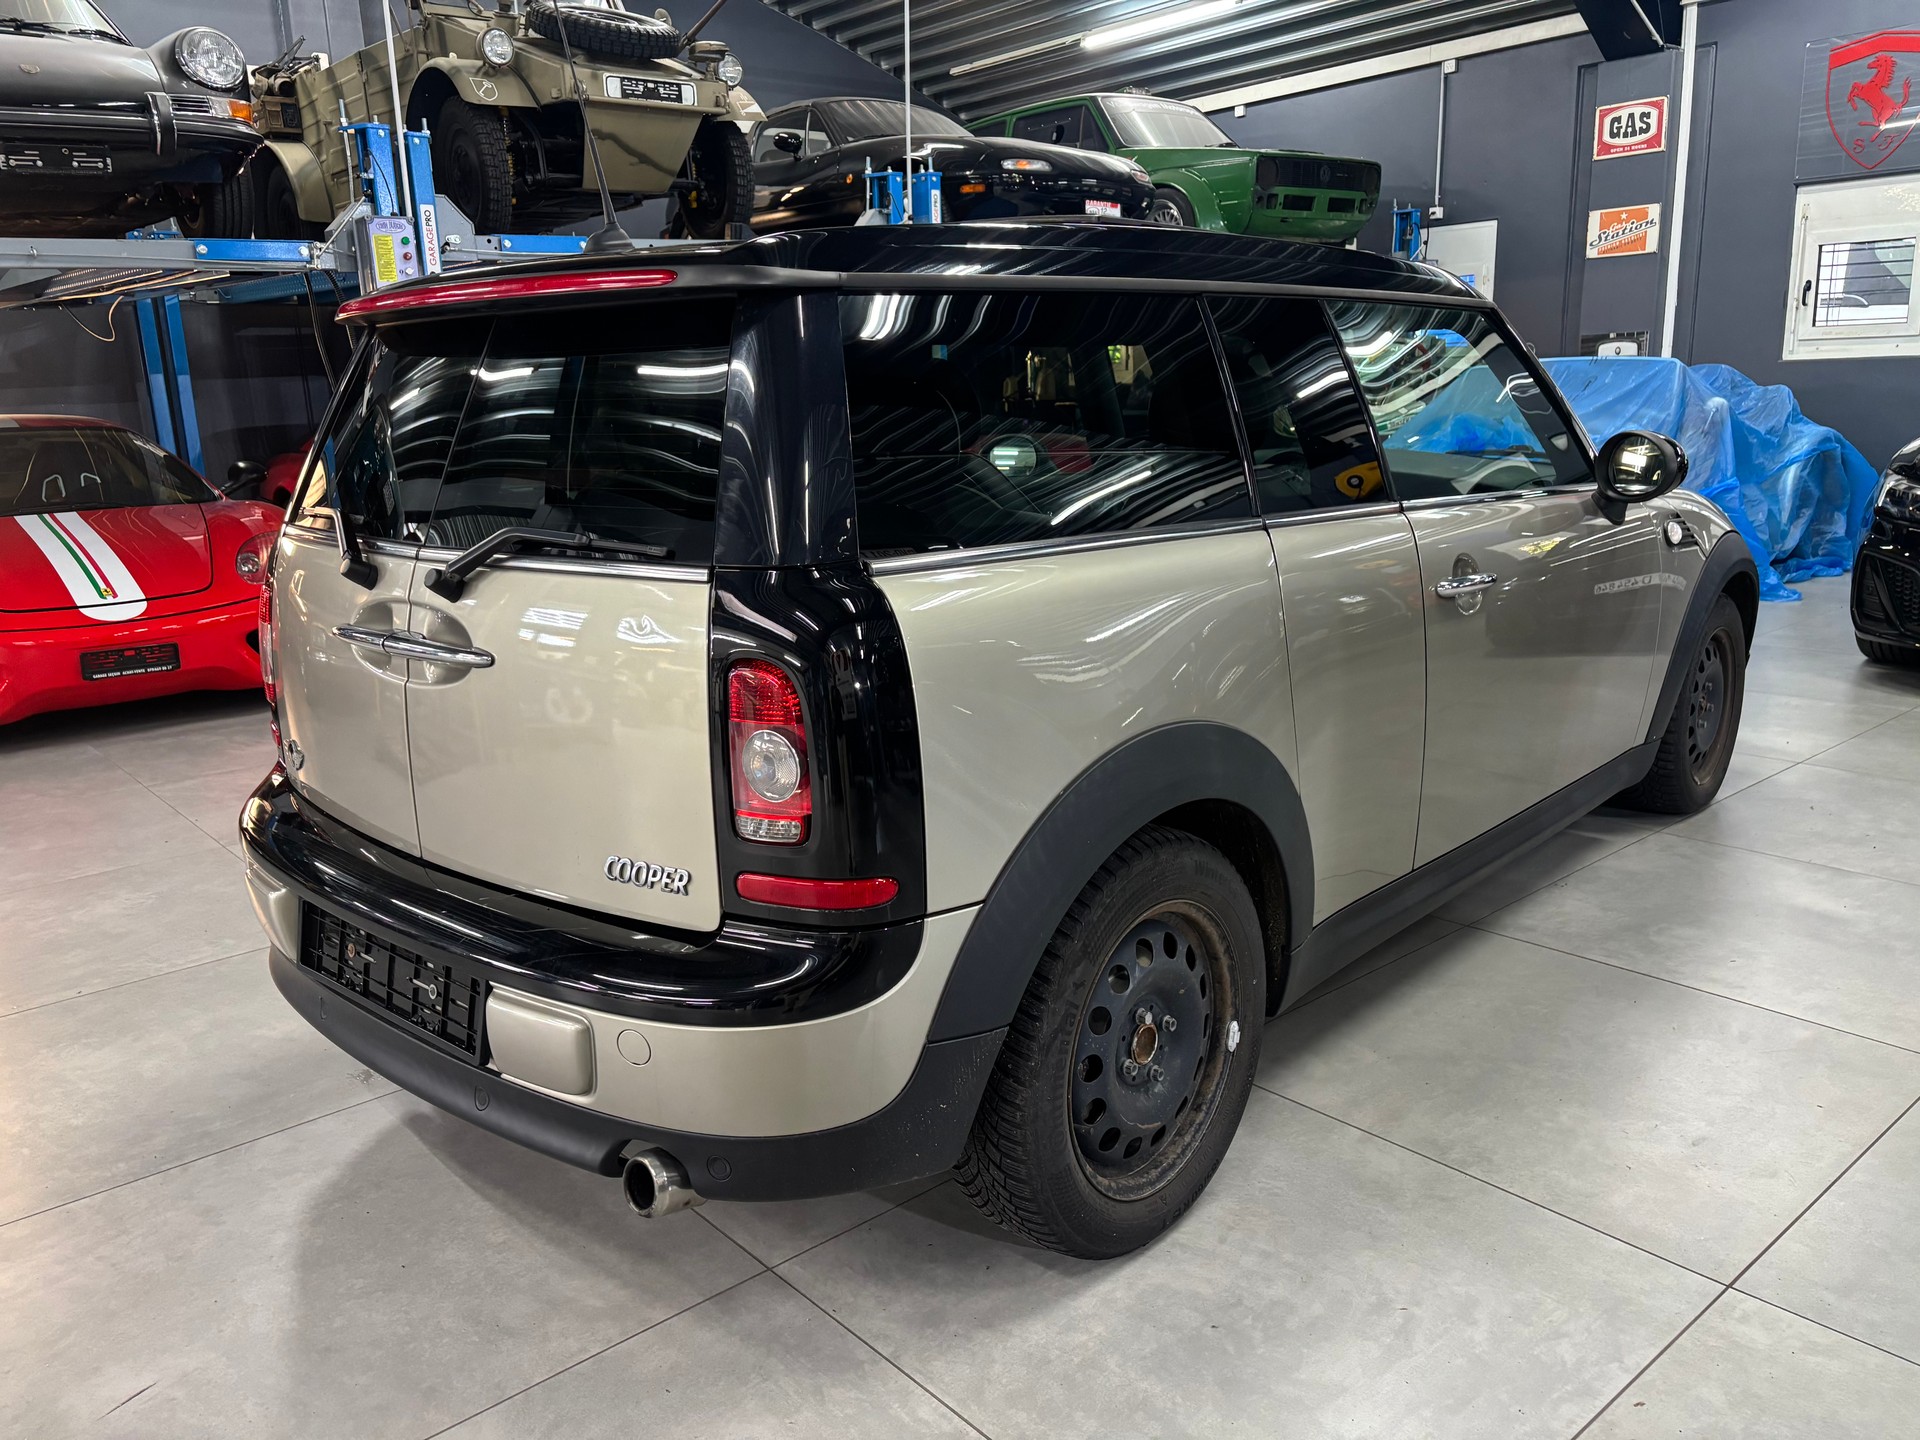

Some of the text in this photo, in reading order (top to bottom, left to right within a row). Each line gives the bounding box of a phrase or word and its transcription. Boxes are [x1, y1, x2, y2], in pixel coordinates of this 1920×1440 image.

[1609, 111, 1651, 139] GAS
[424, 209, 437, 266] GARAGEPRO
[1589, 218, 1657, 247] Station
[603, 855, 692, 897] COOPER
